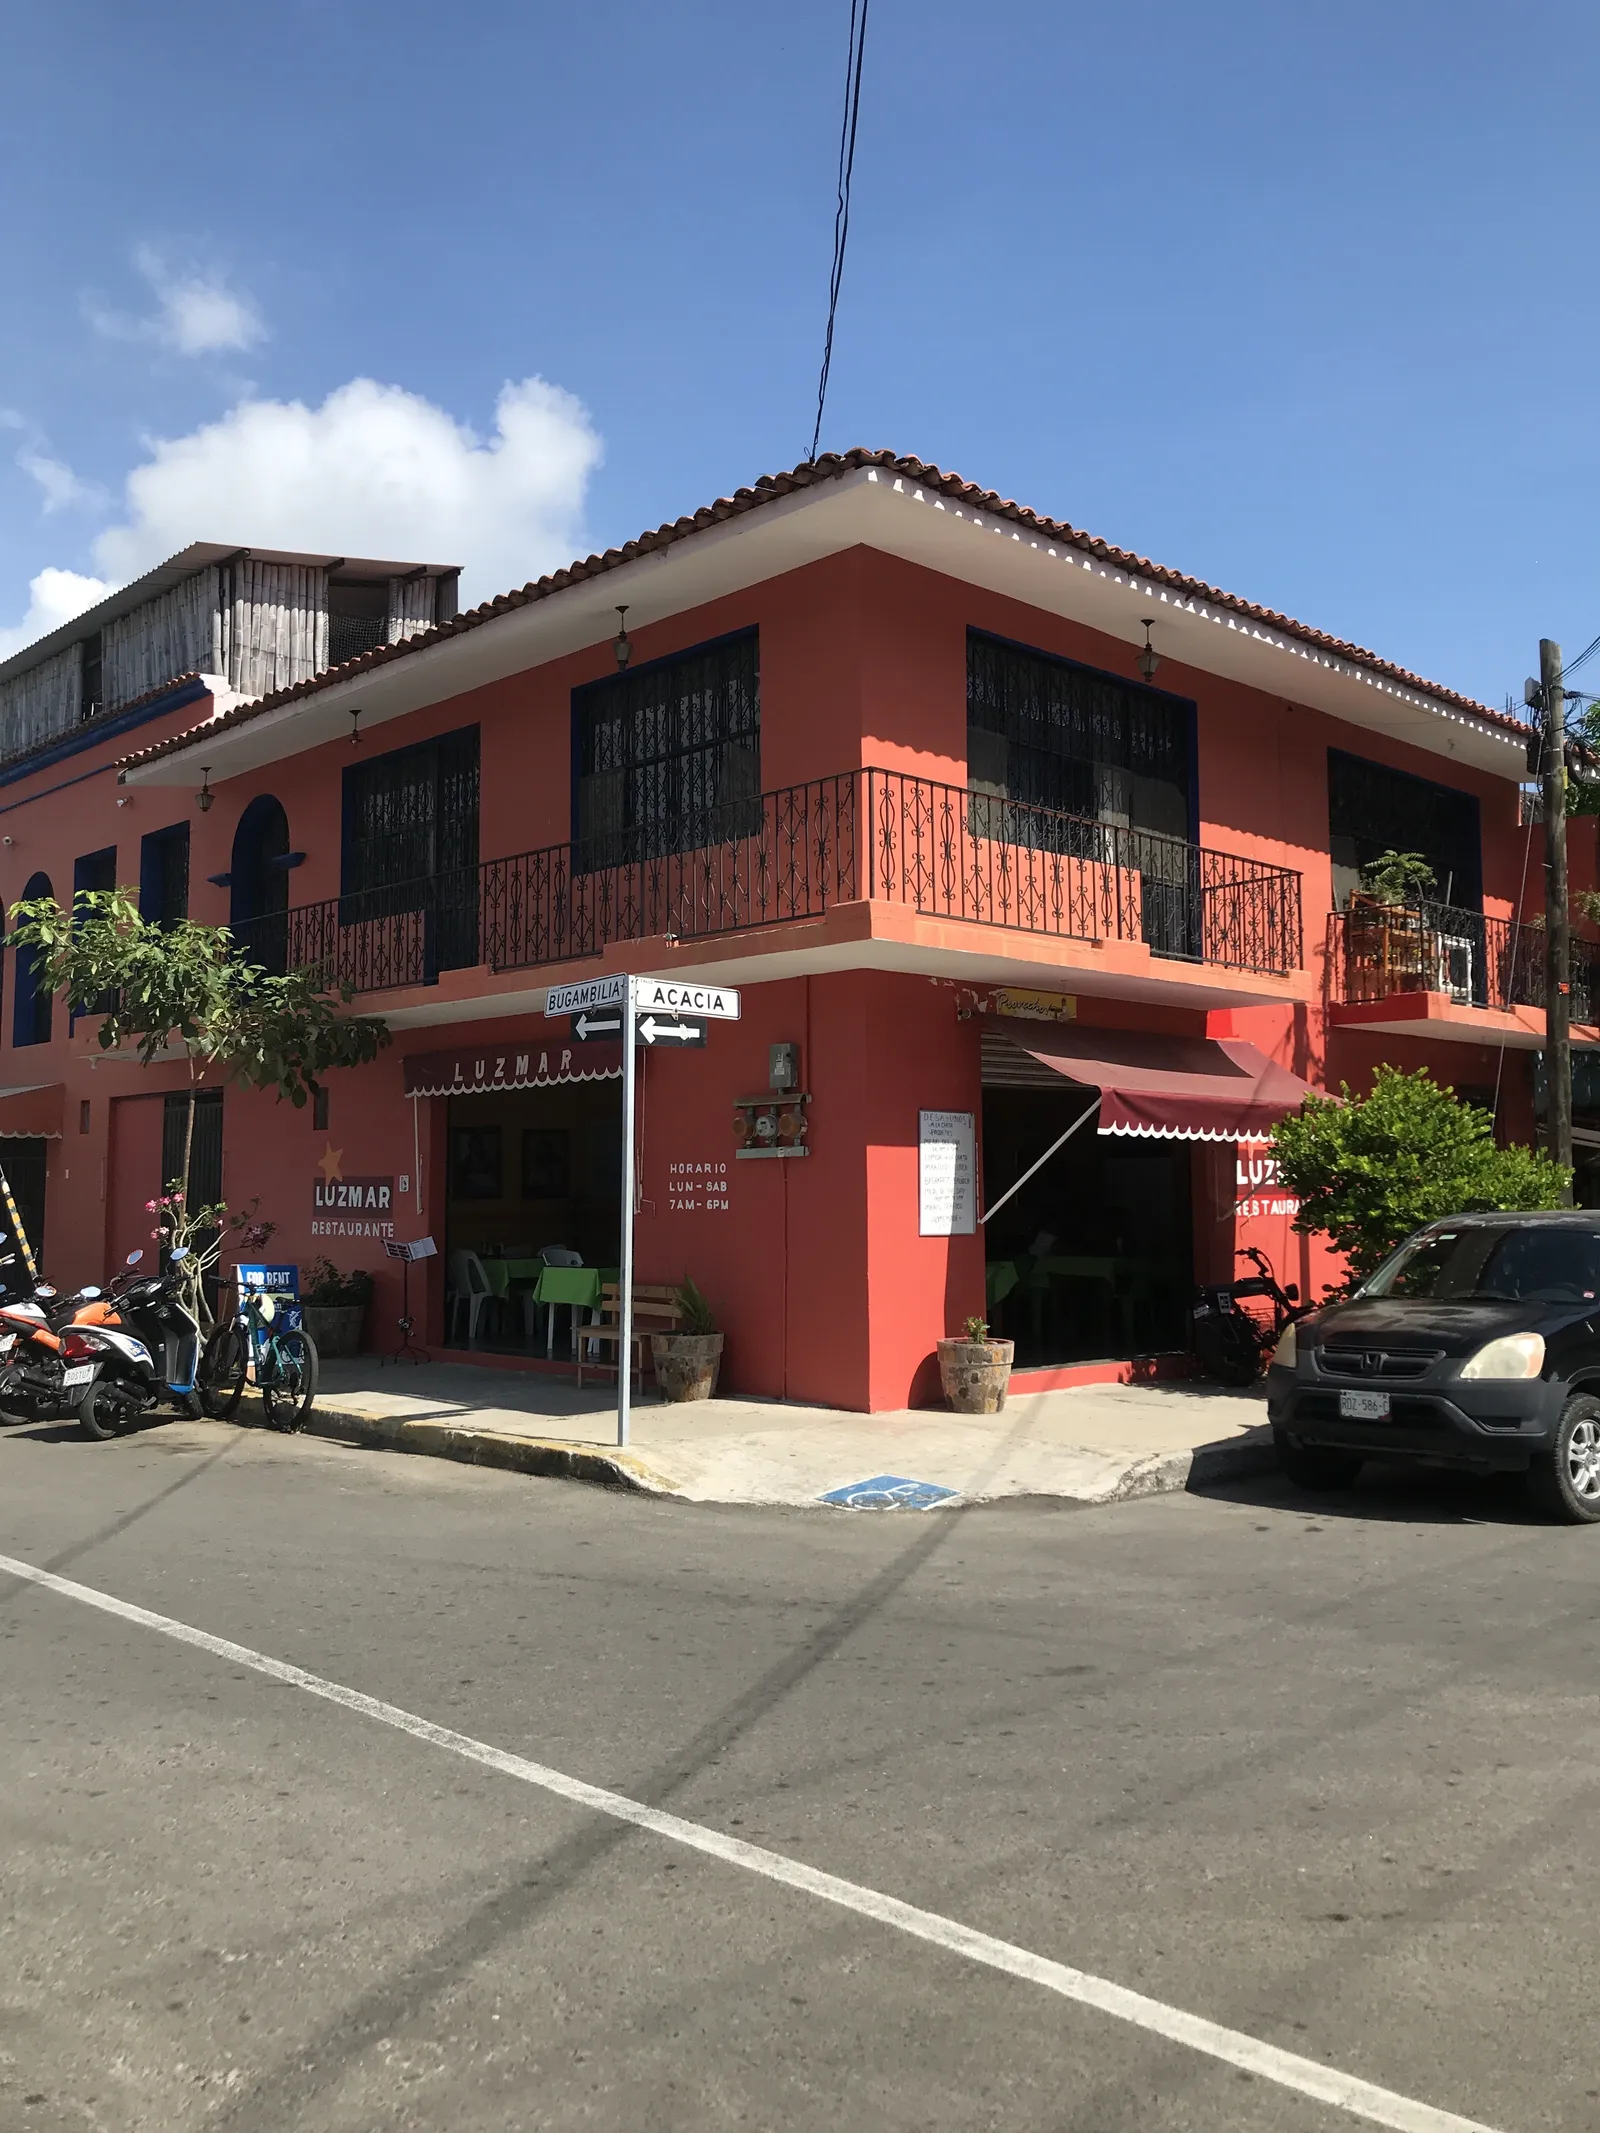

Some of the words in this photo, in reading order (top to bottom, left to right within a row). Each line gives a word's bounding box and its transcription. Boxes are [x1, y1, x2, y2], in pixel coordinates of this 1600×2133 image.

[548, 981, 620, 1011] BUGAMBILIA
[652, 987, 725, 1011] ACACIA
[453, 1049, 572, 1082] LUZMAR
[669, 1162, 727, 1174] HORARIO
[1236, 1159, 1287, 1185] LUZ
[706, 1181, 727, 1192] SAB
[315, 1185, 391, 1209] LUZMAR
[706, 1199, 729, 1210] 6PM
[311, 1221, 394, 1238] RESTAURANTE
[246, 1271, 265, 1286] FOR
[266, 1271, 291, 1285] RENT
